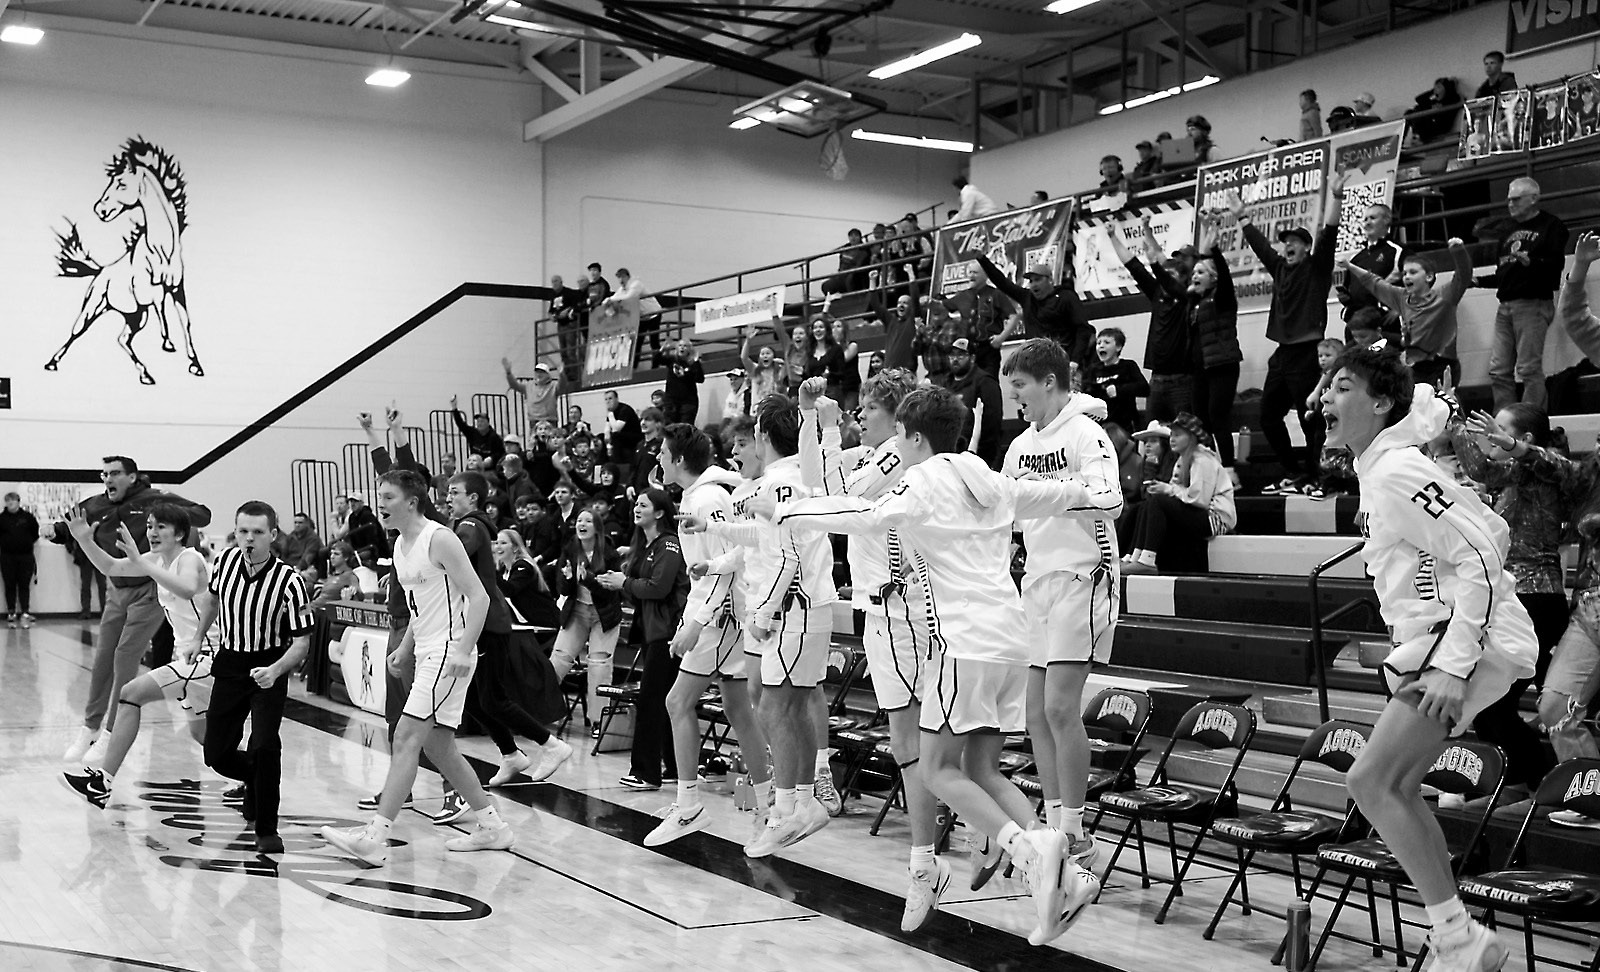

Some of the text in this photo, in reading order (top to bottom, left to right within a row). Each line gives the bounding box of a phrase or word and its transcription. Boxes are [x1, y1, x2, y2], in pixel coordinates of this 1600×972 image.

[1342, 142, 1391, 163] SCAN ME
[1204, 148, 1323, 187] PARK RIVER AREA
[1290, 168, 1321, 194] CLUB
[1123, 223, 1170, 239] Welcme
[946, 265, 966, 280] LIVE
[876, 451, 901, 476] 13
[1018, 447, 1068, 474] CARDINALS
[775, 486, 793, 503] 12
[1411, 481, 1455, 520] 22
[335, 606, 354, 622] HOME
[353, 608, 362, 624] OF
[363, 610, 379, 626] THE
[1096, 694, 1138, 726] AGGIES
[1191, 708, 1238, 742] AGGIES
[1319, 850, 1378, 869] PARK RIVER
[1458, 880, 1530, 904] PARK RIVER
